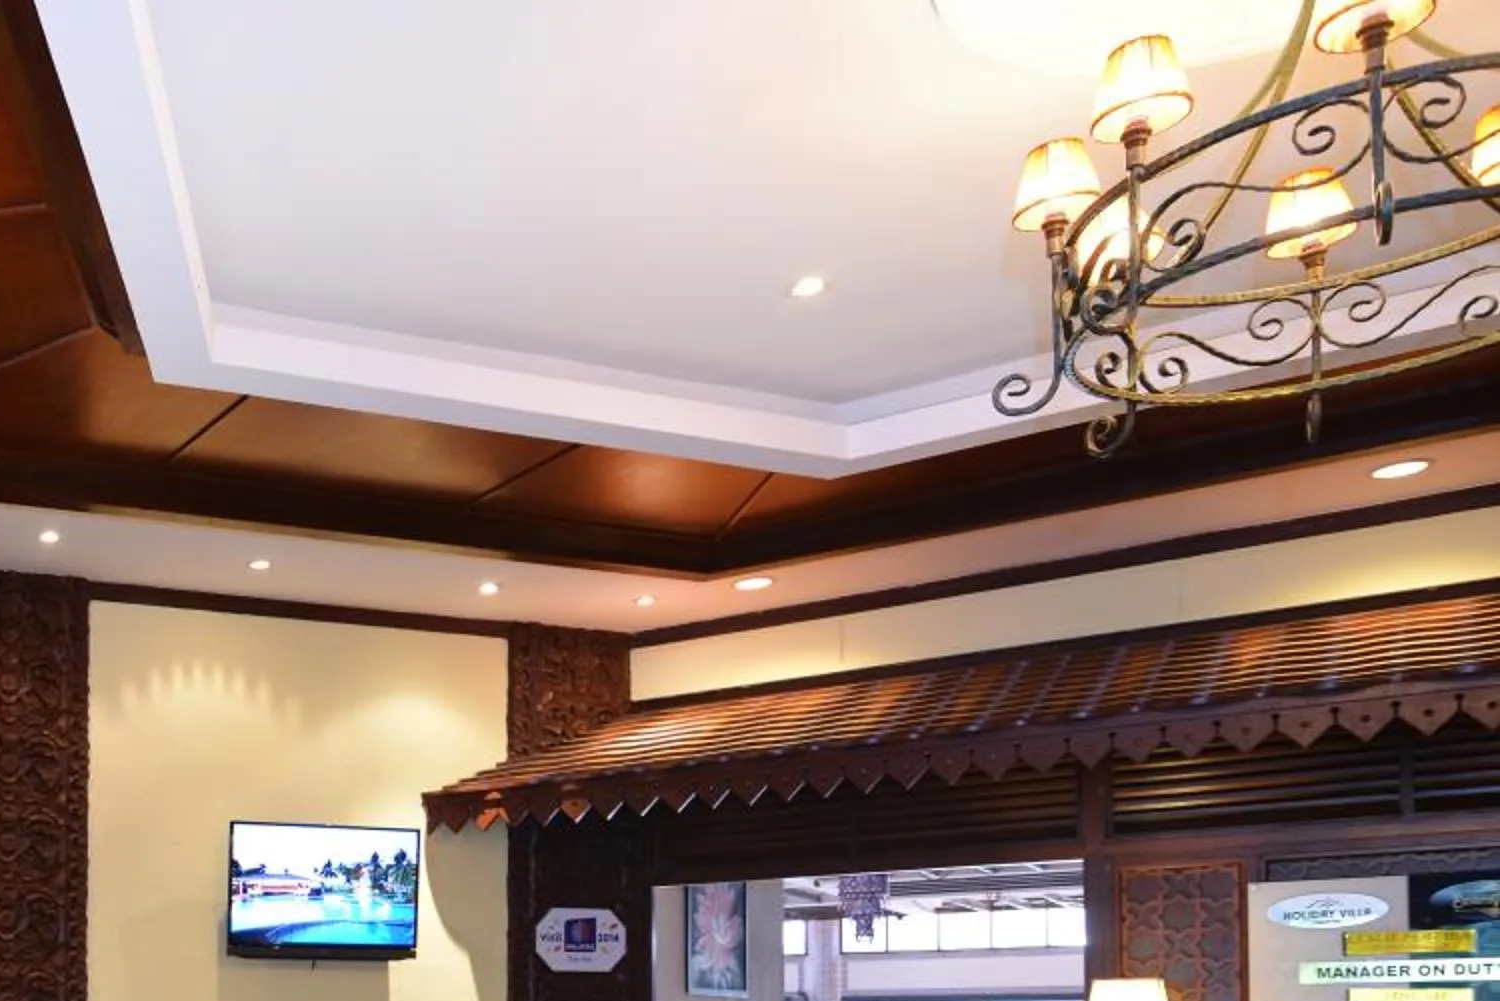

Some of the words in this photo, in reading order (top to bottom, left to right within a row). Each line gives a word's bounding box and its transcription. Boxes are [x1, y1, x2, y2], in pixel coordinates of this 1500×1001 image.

[1283, 910, 1334, 920] HOLIDAY
[1340, 907, 1372, 918] VILLA
[1317, 965, 1411, 978] MANAGER
[1418, 964, 1446, 977] ON
[1454, 963, 1500, 975] DUT
